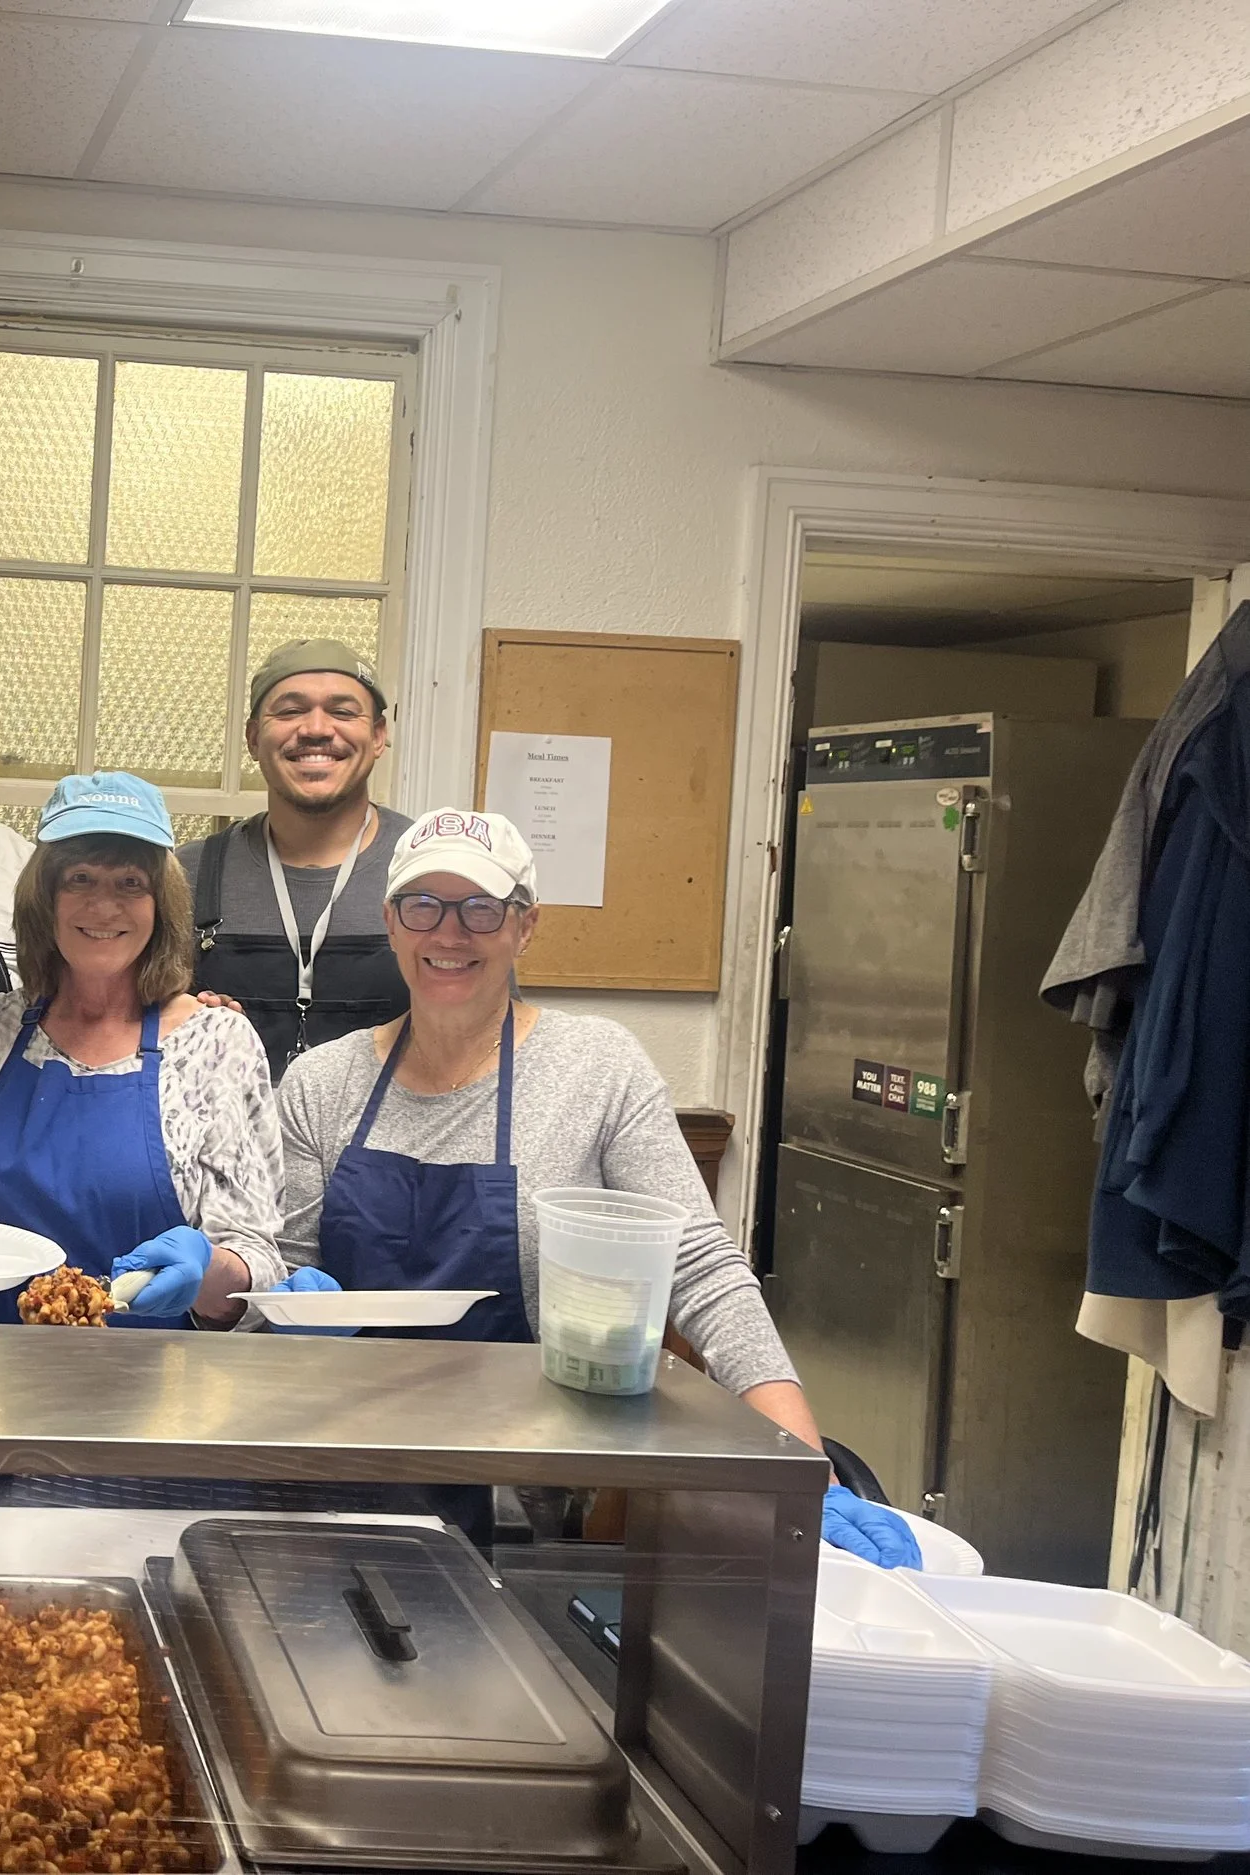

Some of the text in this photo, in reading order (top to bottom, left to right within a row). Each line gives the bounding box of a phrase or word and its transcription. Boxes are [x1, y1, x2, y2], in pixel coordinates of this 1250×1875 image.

[546, 753, 569, 762] Times
[410, 813, 491, 853] USA
[862, 1070, 877, 1082] YOU
[856, 1080, 882, 1094] MATTER
[917, 1080, 937, 1096] 988
